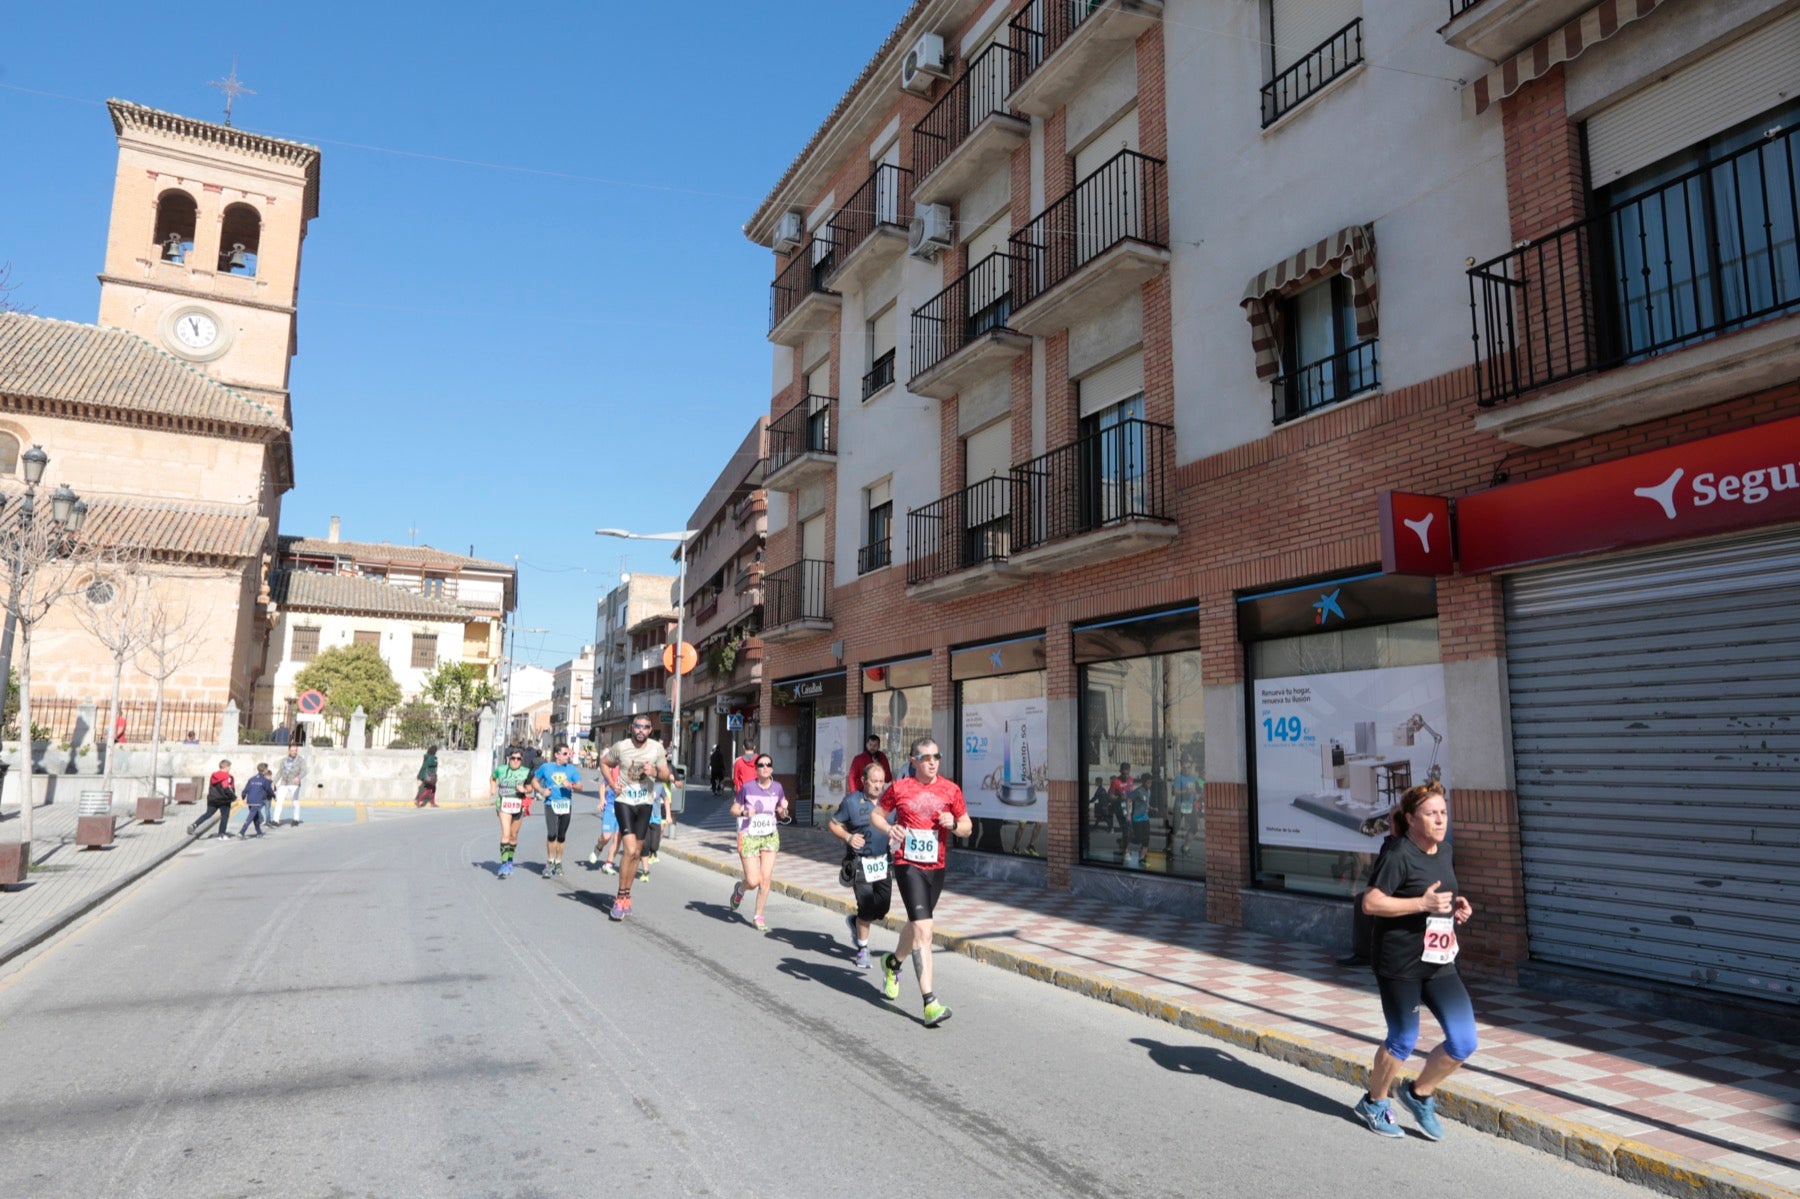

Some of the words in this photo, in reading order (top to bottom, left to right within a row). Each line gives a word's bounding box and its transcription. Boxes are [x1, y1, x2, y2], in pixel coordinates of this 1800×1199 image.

[1692, 462, 1800, 506] Segu
[1263, 716, 1301, 742] 149
[752, 820, 770, 828] 3064
[910, 840, 933, 852] 536
[867, 862, 885, 874] 903
[1428, 932, 1450, 949] 20
